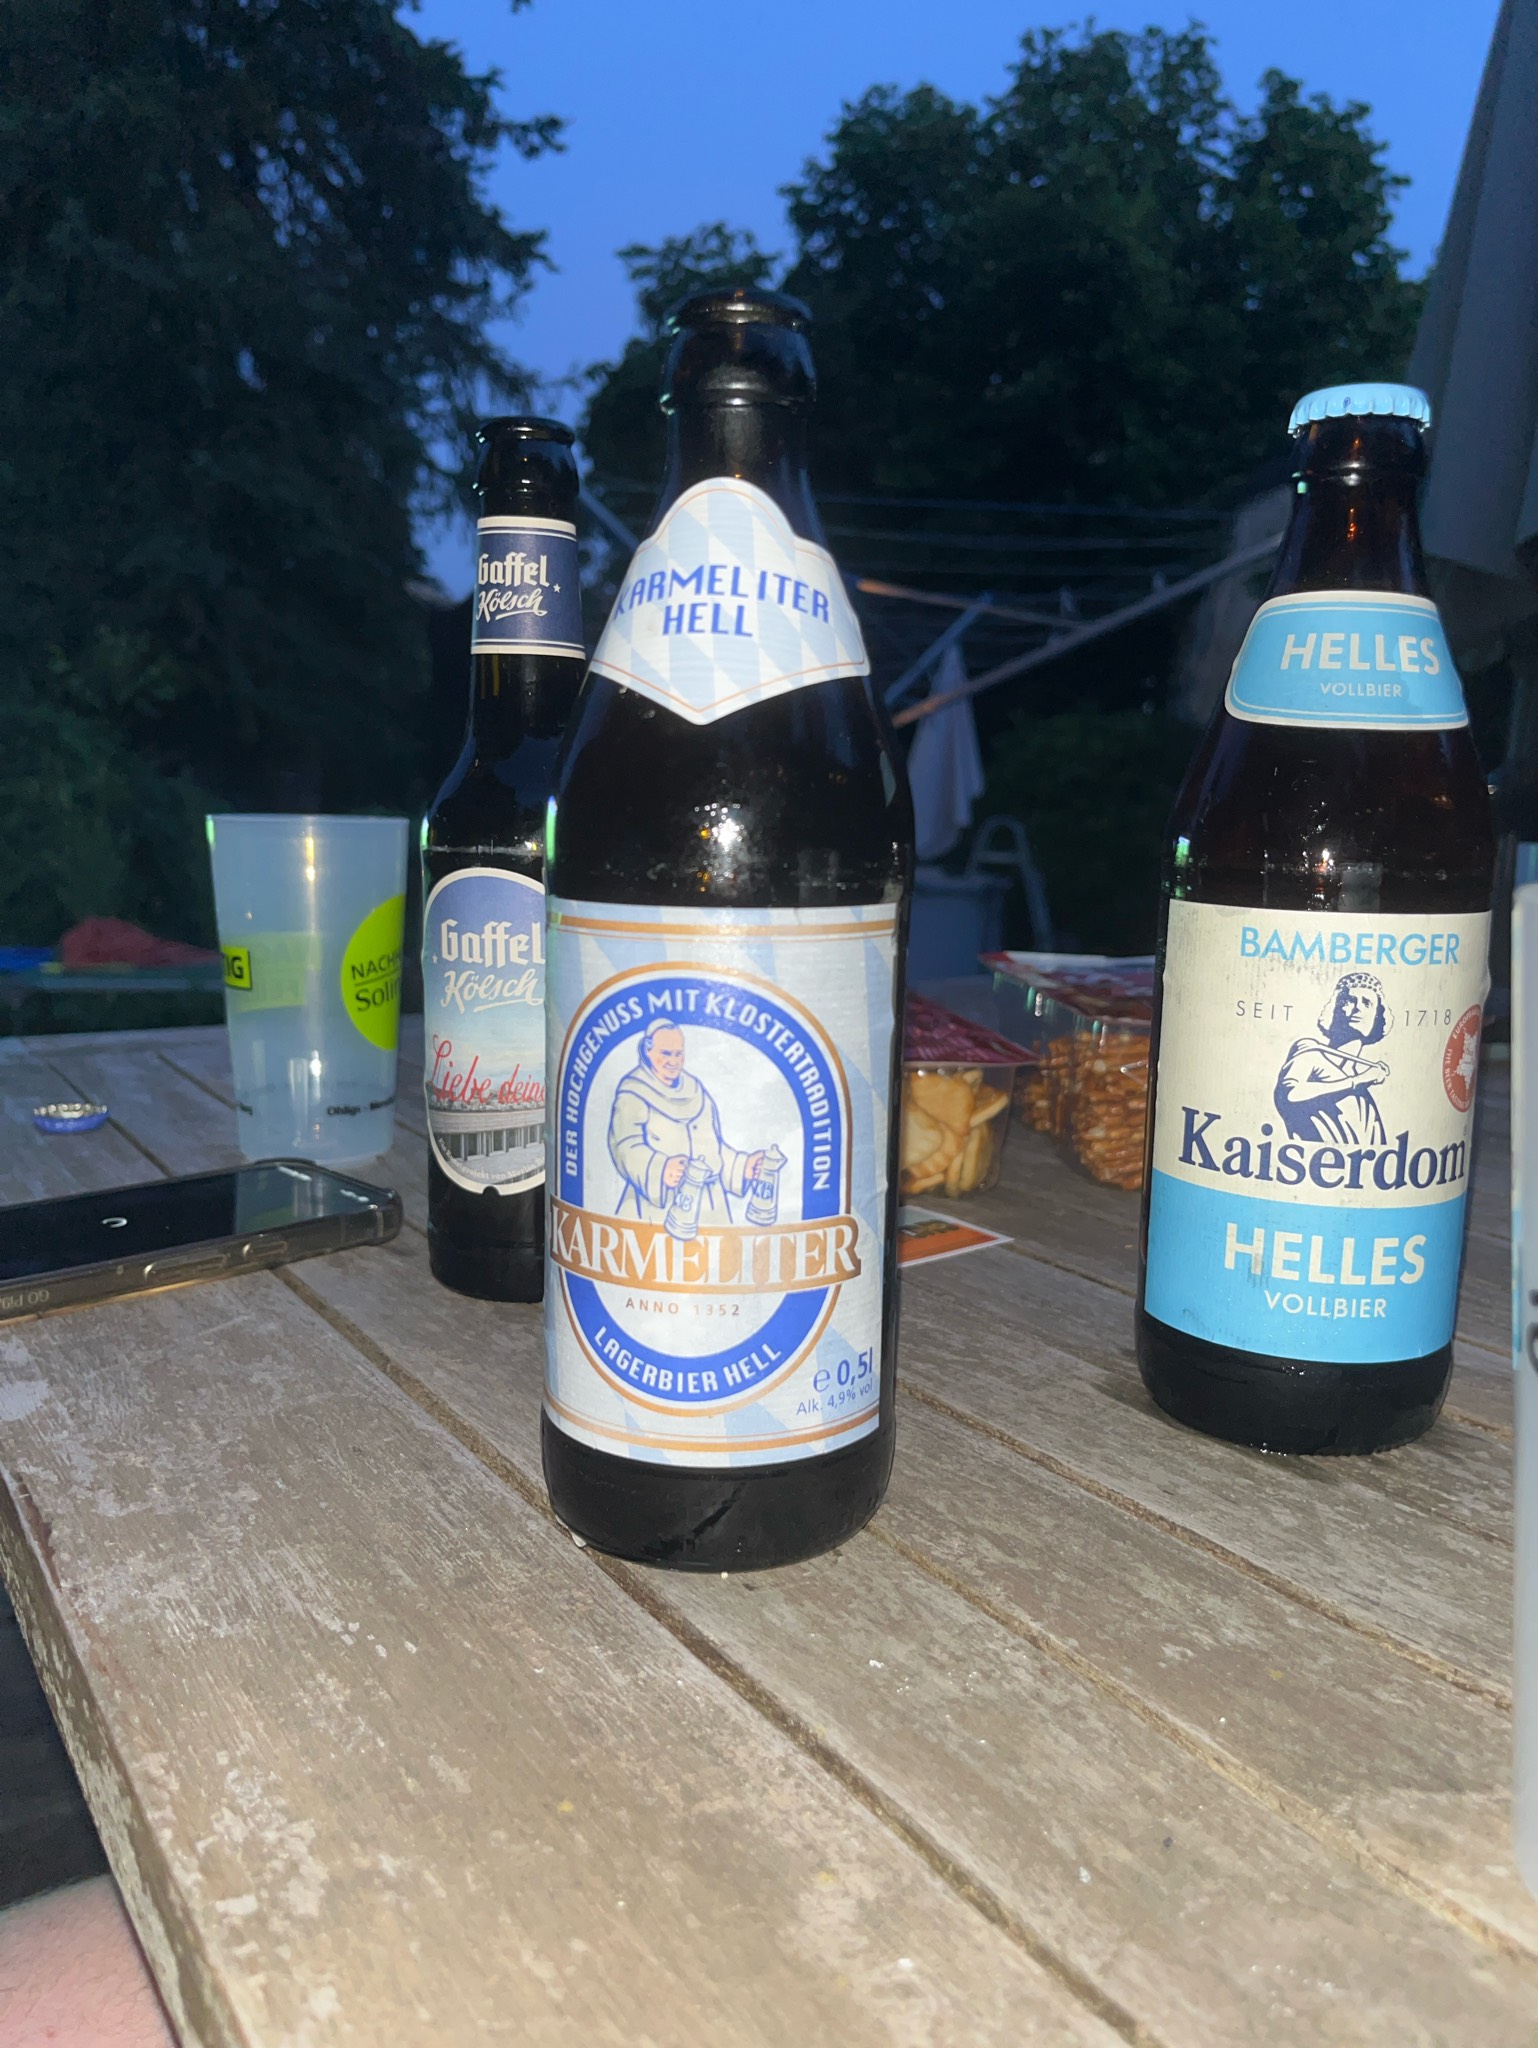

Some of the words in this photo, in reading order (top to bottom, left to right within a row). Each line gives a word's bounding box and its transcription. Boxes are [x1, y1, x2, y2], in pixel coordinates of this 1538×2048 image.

[475, 589, 548, 622] Kölsch
[612, 563, 830, 624] KARMELITER
[662, 602, 754, 638] HELL
[1279, 632, 1440, 675] HELLES
[1319, 682, 1403, 698] VOLLBIER
[440, 918, 545, 969] Gaffel
[1239, 926, 1460, 965] BAMBERGER
[439, 968, 545, 1015] Kölsch
[647, 988, 700, 1013] MIT
[1235, 999, 1294, 1022] SEIT
[1403, 1008, 1452, 1027] 1718
[432, 1034, 492, 1103] Liebe
[565, 996, 644, 1124] HOCHGENUSS
[704, 992, 833, 1191] KLOSTERTRADITION
[565, 1132, 578, 1177] DER
[1177, 1105, 1466, 1191] Kaiserdom
[550, 1203, 858, 1286] KARMELITER
[1223, 1222, 1427, 1286] HELLES
[625, 1297, 680, 1315] ANNO
[693, 1304, 741, 1317] 1352
[1263, 1289, 1387, 1319] VOLLBIER
[593, 1325, 719, 1395] LAGERBIER
[722, 1342, 782, 1388] HELL
[796, 1400, 823, 1416] Alk.
[827, 1387, 857, 1410] 4,9%
[859, 1378, 874, 1397] vol
